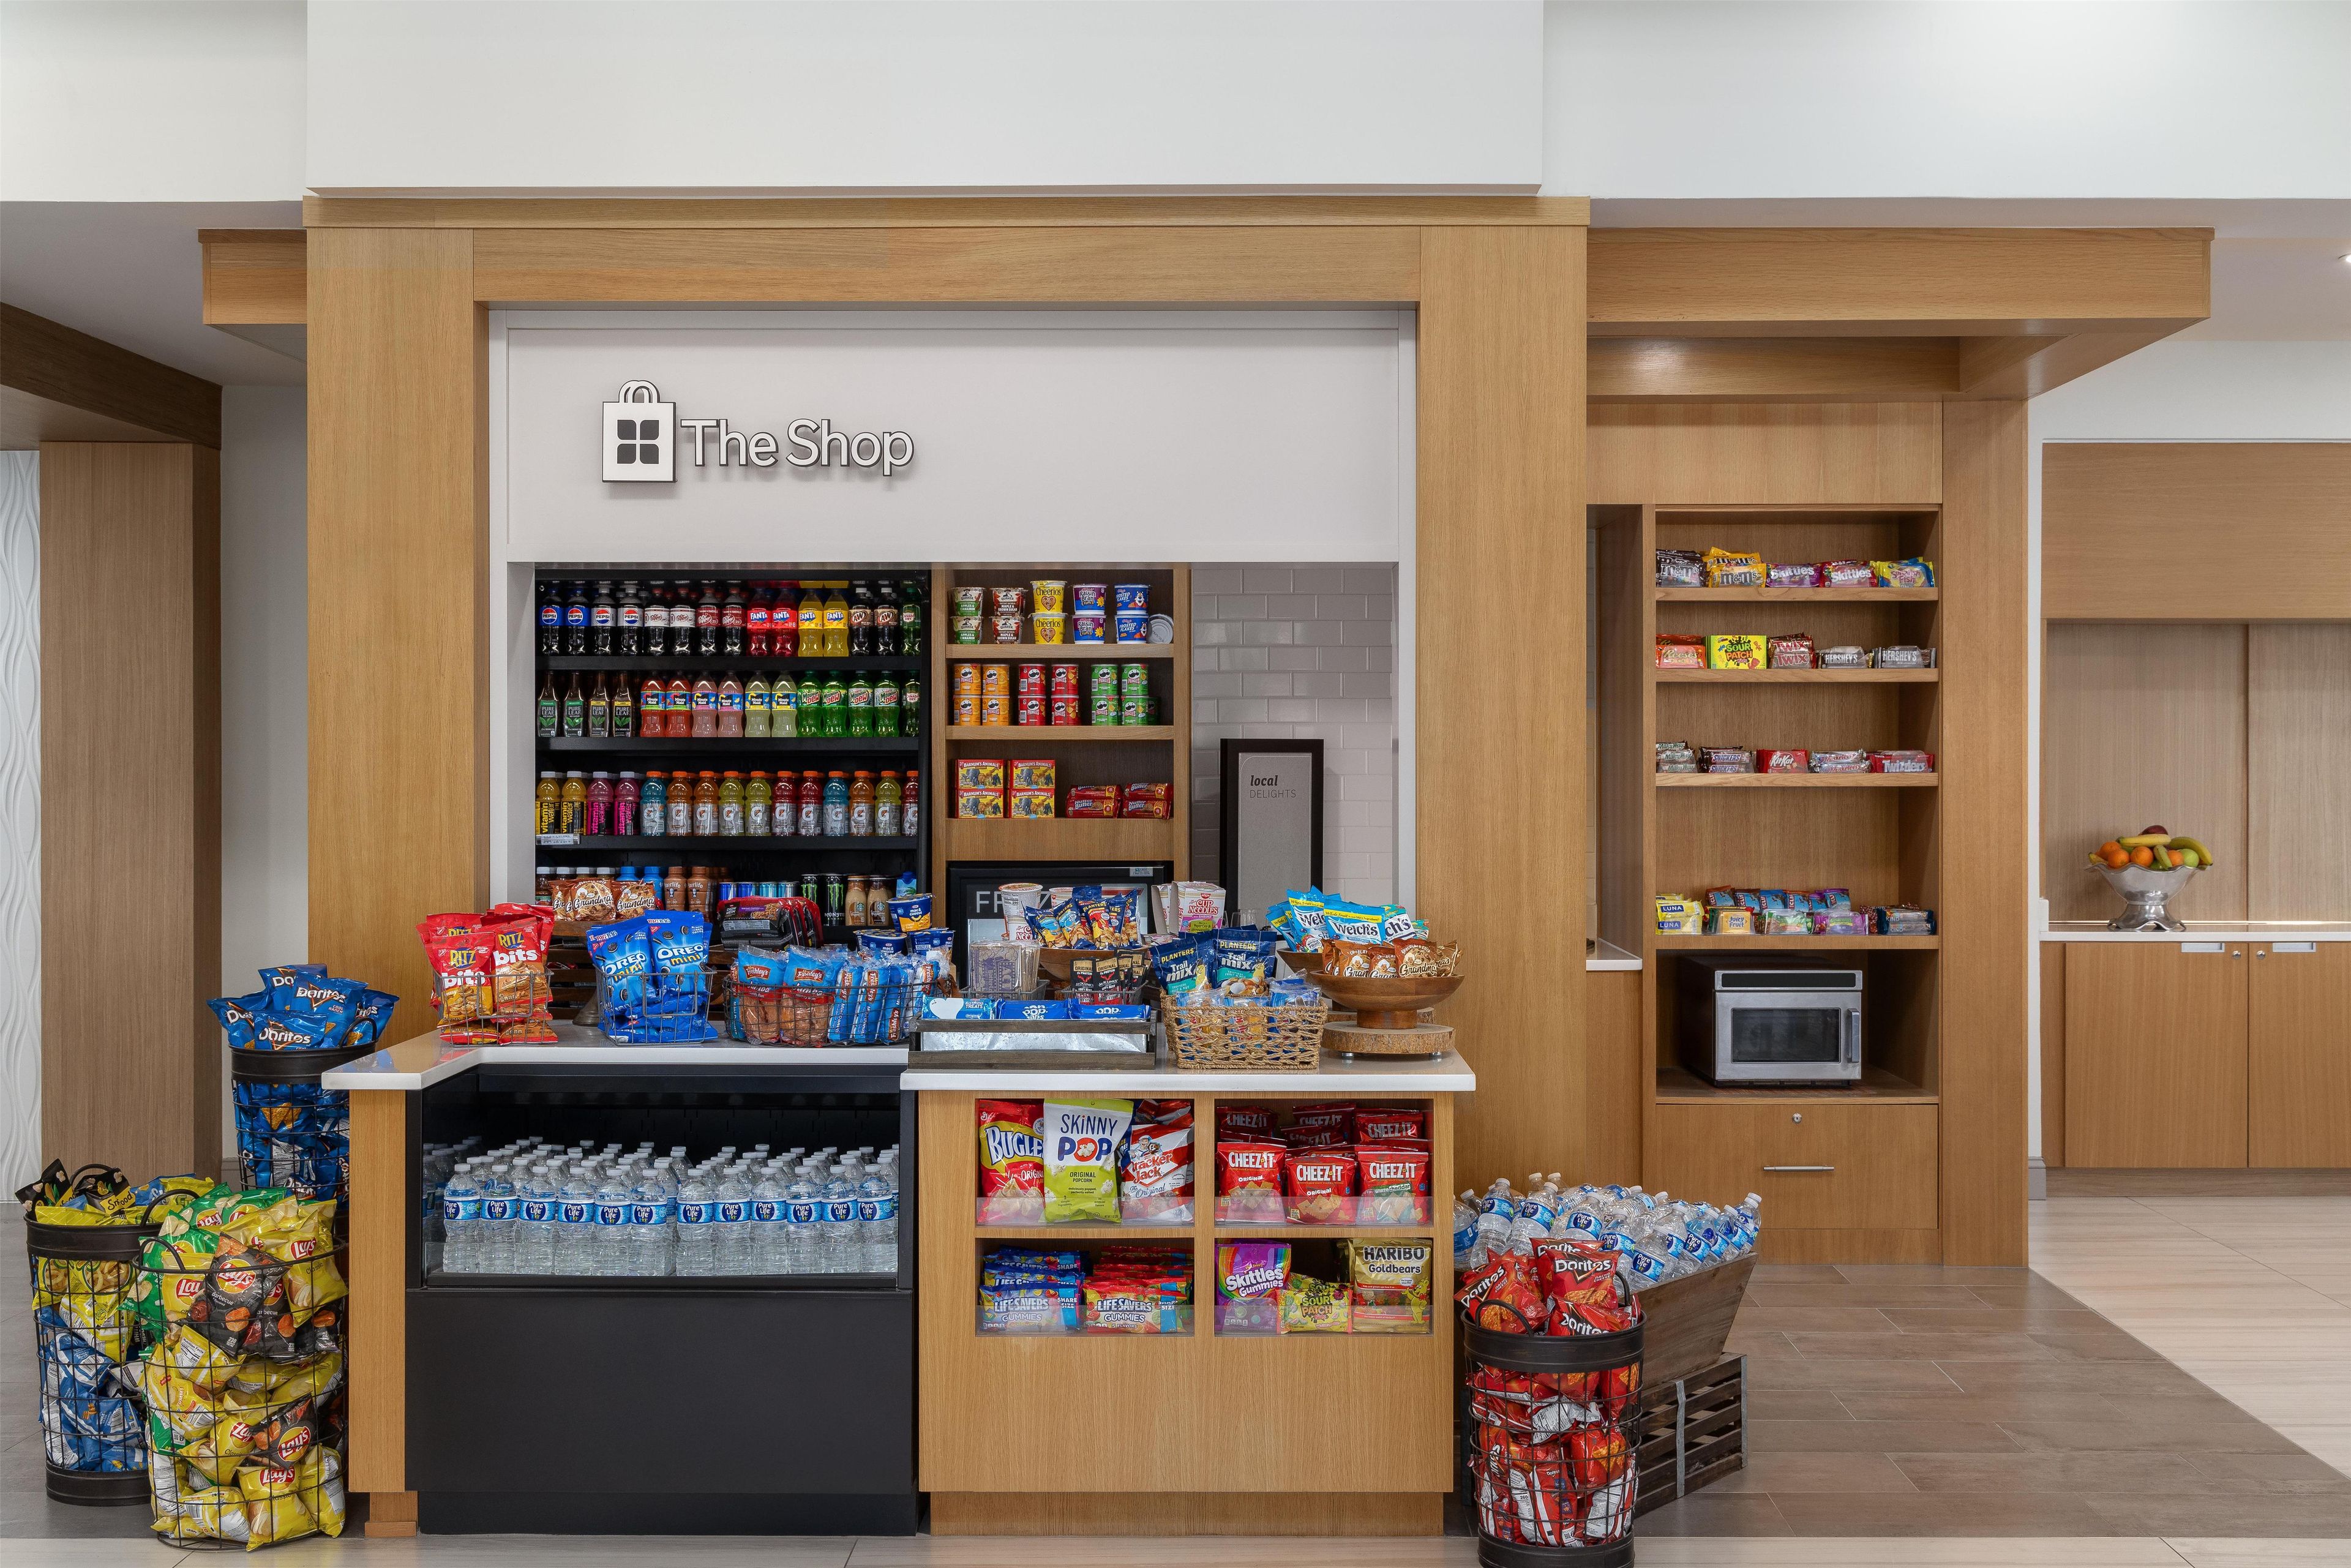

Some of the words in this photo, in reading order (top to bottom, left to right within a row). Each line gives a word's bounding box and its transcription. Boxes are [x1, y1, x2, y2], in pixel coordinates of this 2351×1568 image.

[680, 418, 779, 467] The
[786, 418, 915, 476] Shop
[1770, 566, 1815, 580] Skittles
[1831, 569, 1872, 582] Skittles
[1036, 587, 1061, 596] Cheerios
[1725, 643, 1751, 651] SOUR
[1726, 650, 1753, 661] PATCH
[1825, 654, 1858, 664] HERSHEY'S
[1883, 651, 1917, 662] HERSHEY'S
[807, 695, 820, 704] DEW
[855, 695, 868, 704] DEW
[1250, 775, 1278, 787] local
[1250, 789, 1296, 798] DELIGHTS
[697, 807, 707, 820] G
[775, 807, 787, 820] G
[1082, 902, 1107, 912] PLANTERS
[1333, 921, 1378, 936] Welch's
[498, 931, 525, 947] RITZ
[1220, 940, 1256, 951] PLANTERS
[449, 950, 476, 967] RITZ
[492, 950, 538, 966] bits
[658, 945, 703, 959] OREO
[1161, 948, 1194, 964] PLANTERS
[1228, 953, 1247, 961] Trail
[604, 953, 646, 975] OREO
[670, 953, 701, 966] mini
[1171, 960, 1188, 972] Trail
[1221, 958, 1251, 970] mix
[747, 967, 770, 976] Freshley's
[1098, 963, 1117, 972] ORIGINAL
[1166, 966, 1194, 981] mix
[296, 987, 347, 1003] Doritos
[258, 1027, 311, 1044] Doritos
[984, 1125, 1044, 1166] BUGLE
[1057, 1136, 1112, 1162] POP
[1133, 1166, 1162, 1184] Jack
[1135, 1183, 1166, 1198] Original
[1687, 1239, 1698, 1247] Life
[1688, 1233, 1701, 1245] Pure
[1363, 1247, 1425, 1261] HARIBO
[1637, 1253, 1651, 1264] Pure
[1368, 1264, 1422, 1274] Goldbears
[1555, 1259, 1611, 1272] Doritos
[1637, 1259, 1648, 1268] Life
[1225, 1267, 1284, 1291] Skittles
[1239, 1280, 1284, 1297] Gummies
[1460, 1265, 1505, 1308] Doritos
[211, 1291, 234, 1306] Barbecue
[1302, 1296, 1330, 1306] SOUR
[1302, 1305, 1333, 1316] PATCH
[1002, 1314, 1041, 1322] GUMMIES
[1104, 1314, 1146, 1323] GUMMIES
[280, 1427, 310, 1460] Lay's
[261, 1468, 293, 1484] Lay's
